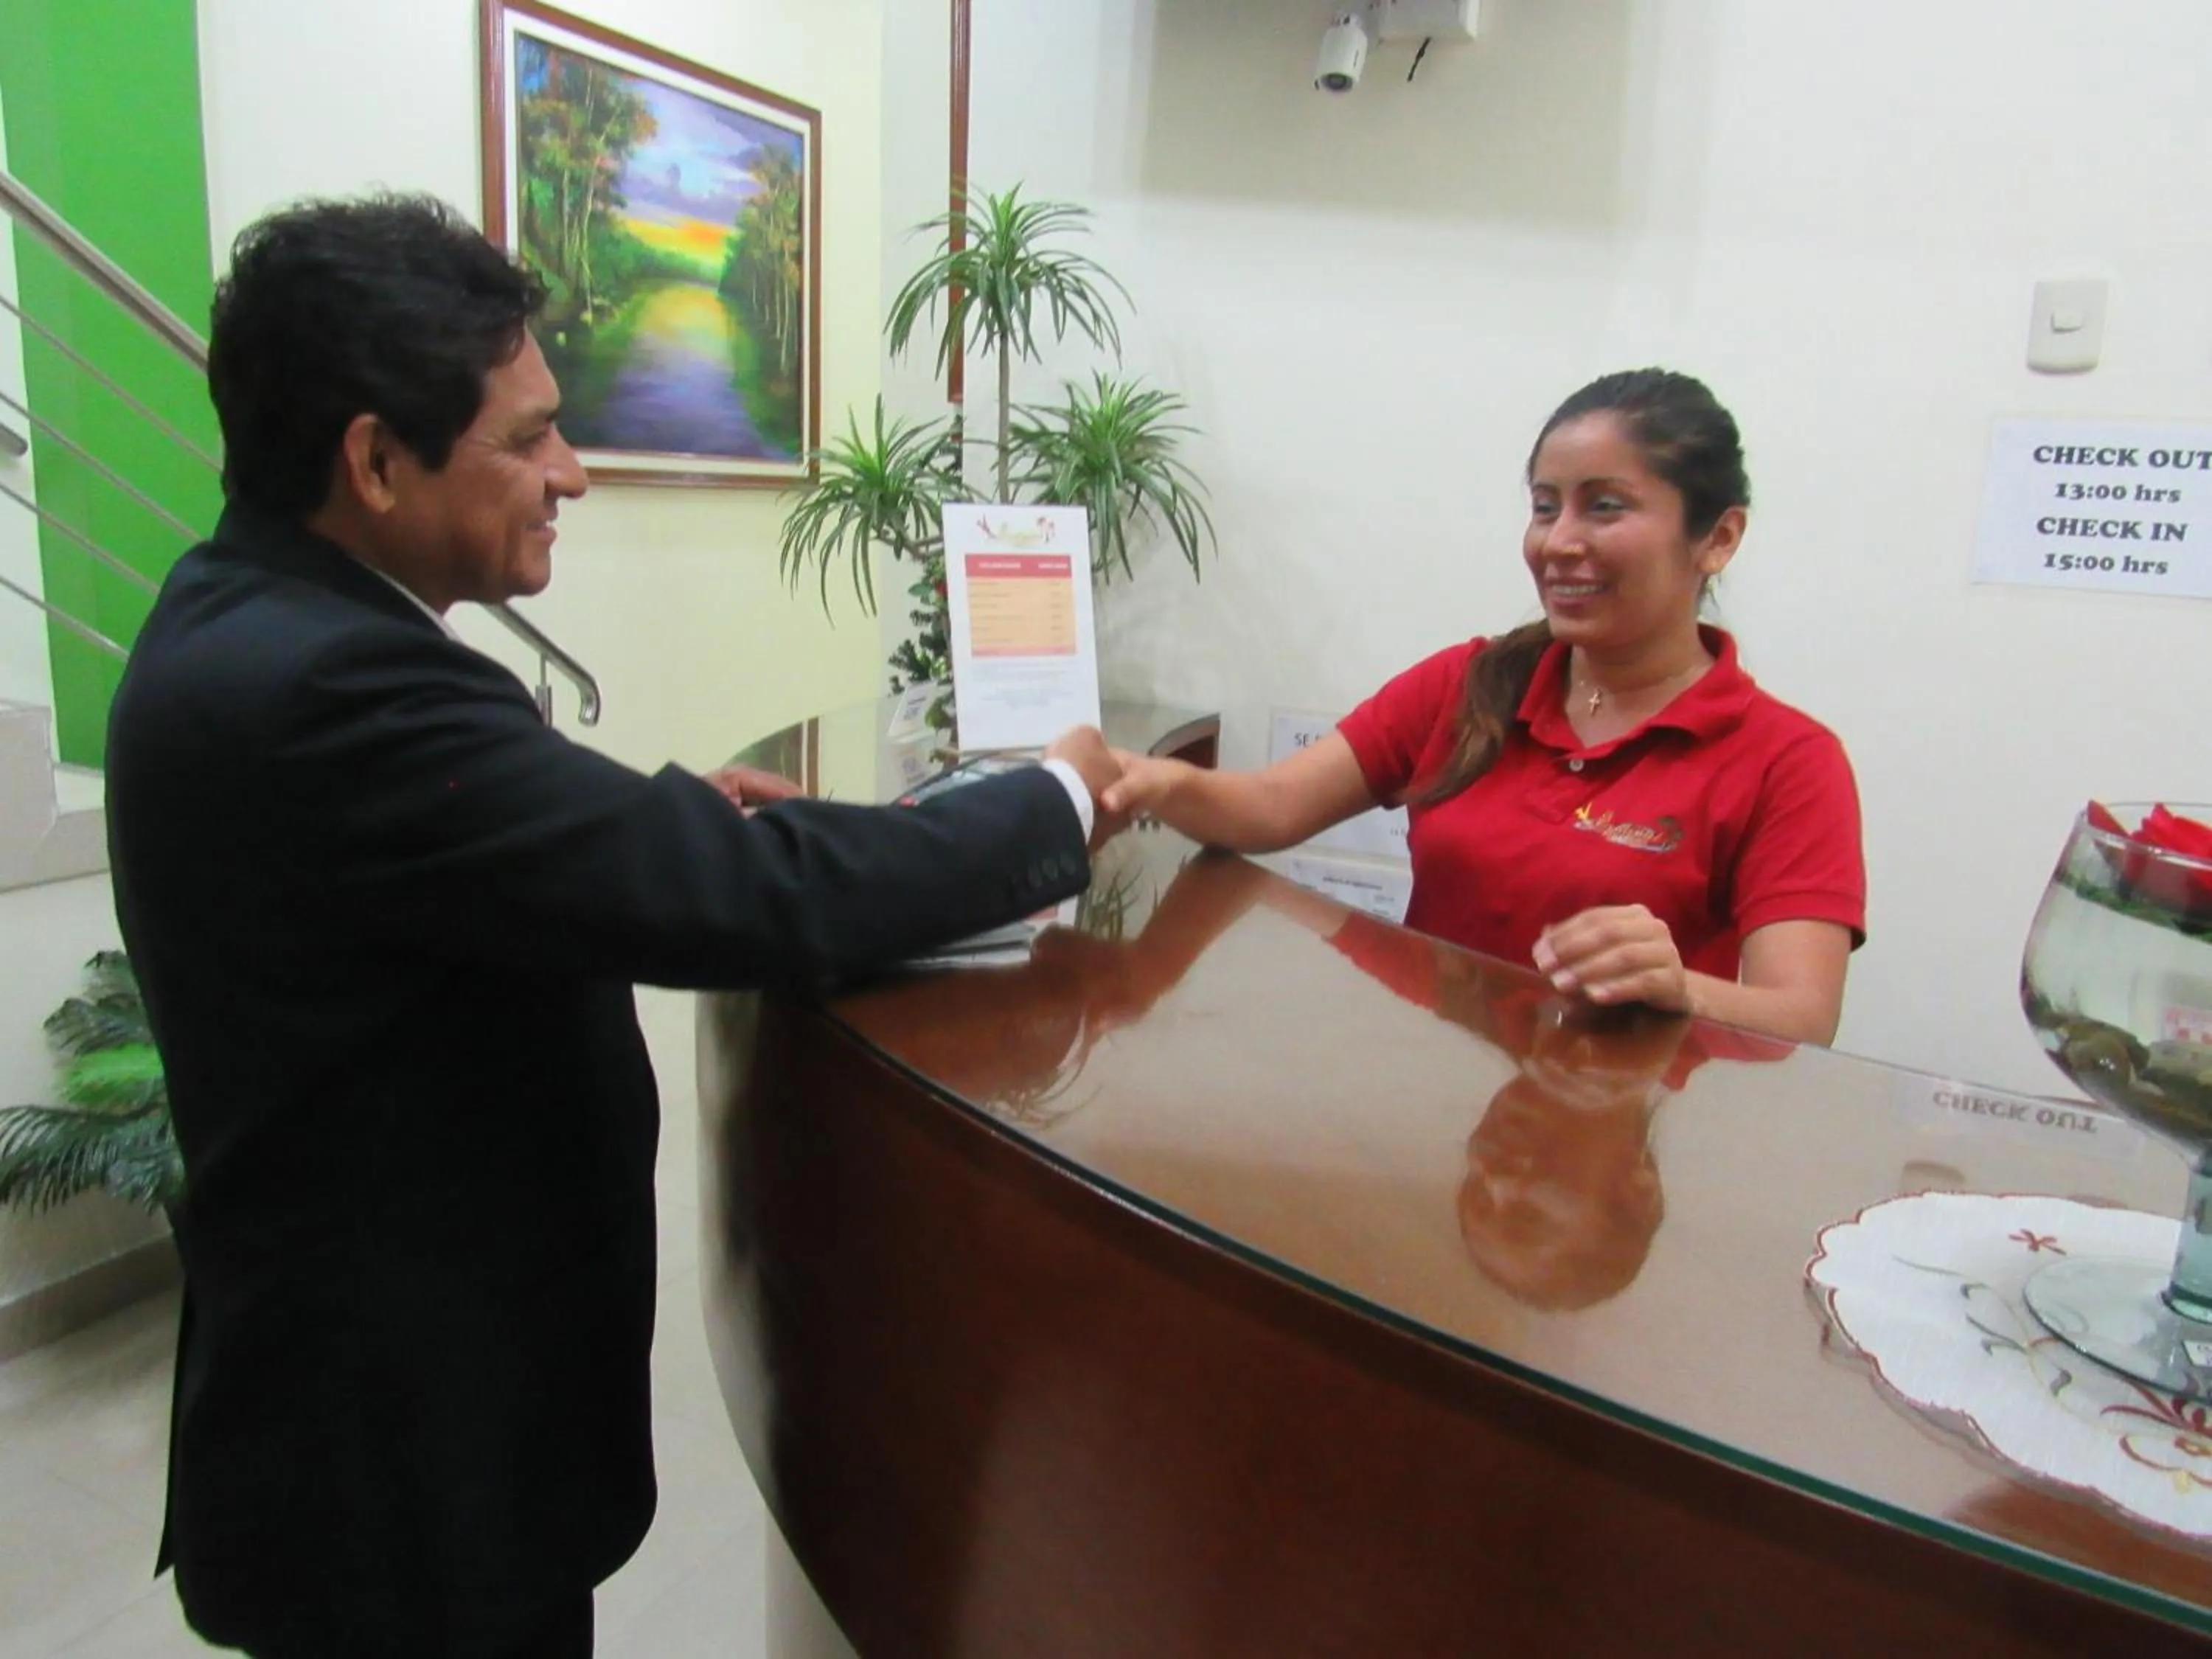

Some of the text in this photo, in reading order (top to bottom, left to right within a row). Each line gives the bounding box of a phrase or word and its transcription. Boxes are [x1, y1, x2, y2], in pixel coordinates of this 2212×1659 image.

[2033, 445, 2212, 470] CHECK OUT
[2055, 483, 2181, 503] 13:00 hrs
[2037, 517, 2188, 542] CHECK IN
[2044, 553, 2168, 575] 15:00 hrs
